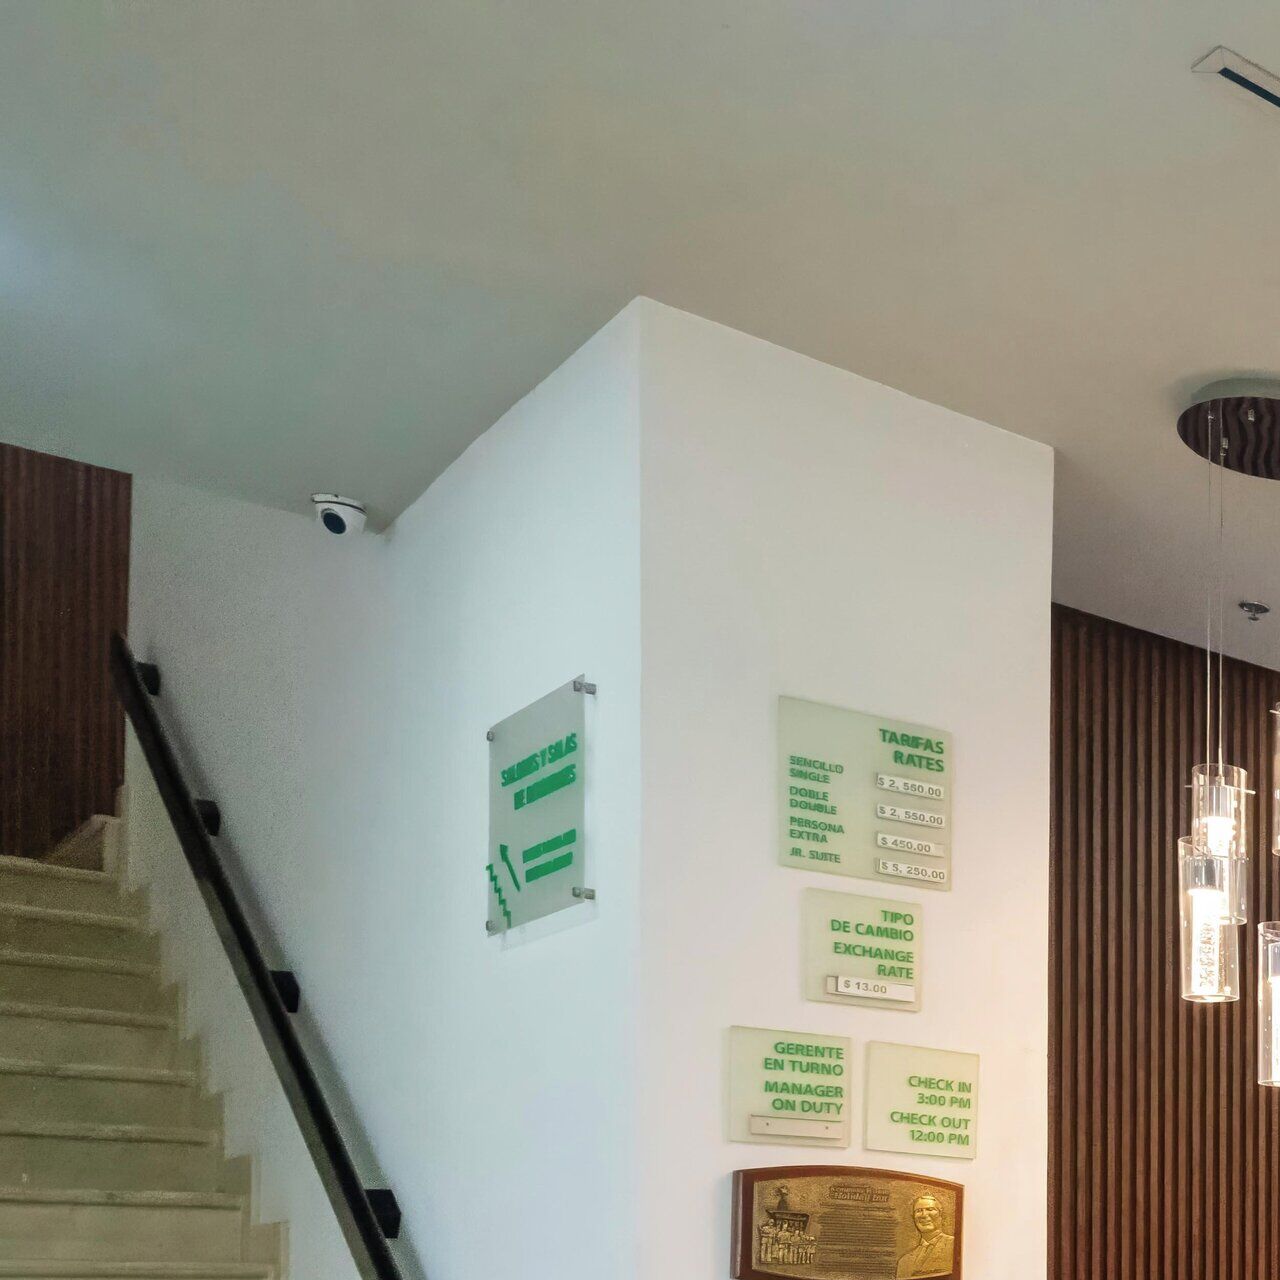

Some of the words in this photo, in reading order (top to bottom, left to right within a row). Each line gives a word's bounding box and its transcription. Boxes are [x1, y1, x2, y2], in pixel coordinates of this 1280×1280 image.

[879, 728, 944, 755] TARIFAS
[790, 755, 844, 774] SENCILLO
[893, 750, 945, 772] RATES
[789, 768, 831, 784] SINGLE
[789, 785, 829, 802] DOBLE
[789, 798, 837, 815] DOUBLE
[789, 815, 845, 834] PERSONA
[879, 806, 886, 815] $
[904, 810, 943, 826] 550.00
[789, 828, 828, 843] EXTRA
[881, 837, 888, 846] $
[891, 839, 931, 853] 450.00
[789, 847, 806, 858] JR.
[808, 850, 841, 864] SUITE
[906, 866, 945, 880] 250.00
[881, 909, 914, 926] TIPO
[830, 919, 851, 934] DE
[855, 922, 914, 942] CAMBIO
[833, 941, 914, 963] EXCHANGE
[877, 964, 914, 980] RATE
[843, 979, 851, 989] $
[855, 981, 887, 994] 13.00
[774, 1041, 844, 1060] GERENTE
[764, 1057, 785, 1071] EN
[789, 1060, 844, 1076] TURNO
[764, 1080, 843, 1098] MANAGER
[908, 1075, 954, 1092] CHECK
[957, 1081, 972, 1093] IN
[771, 1098, 796, 1111] ON
[801, 1100, 843, 1115] DUTY
[917, 1092, 946, 1106] 3:00
[949, 1096, 971, 1110] PM
[890, 1111, 937, 1127] CHECK
[941, 1116, 971, 1130] OUT
[909, 1129, 945, 1143] 12:00
[948, 1132, 970, 1146] PM
